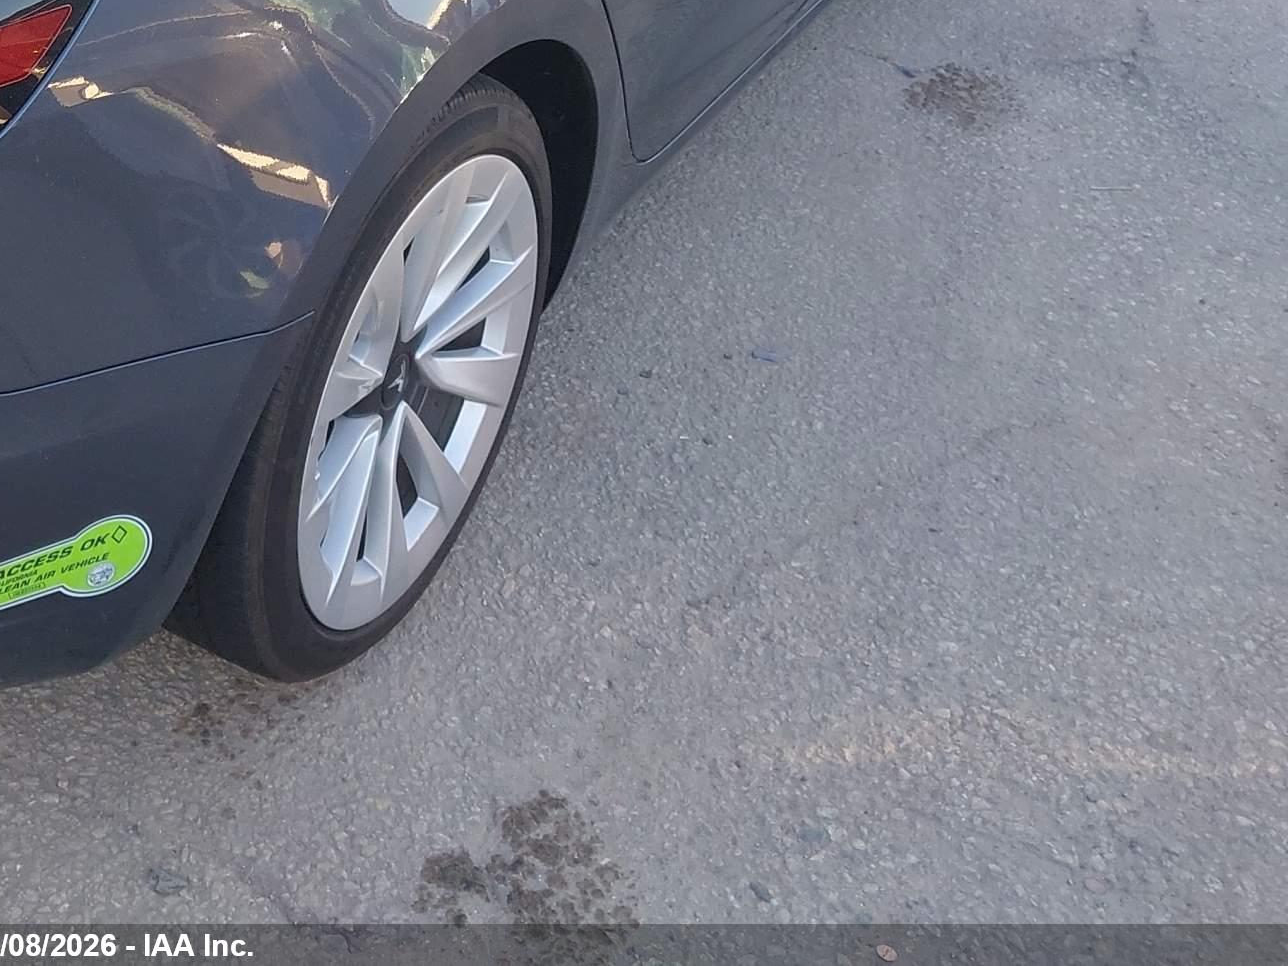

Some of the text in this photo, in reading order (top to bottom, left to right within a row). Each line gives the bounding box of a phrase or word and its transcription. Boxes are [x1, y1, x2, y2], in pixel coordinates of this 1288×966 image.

[80, 533, 110, 551] OK
[35, 570, 56, 582] AIR
[61, 553, 110, 574] VEHICLE
